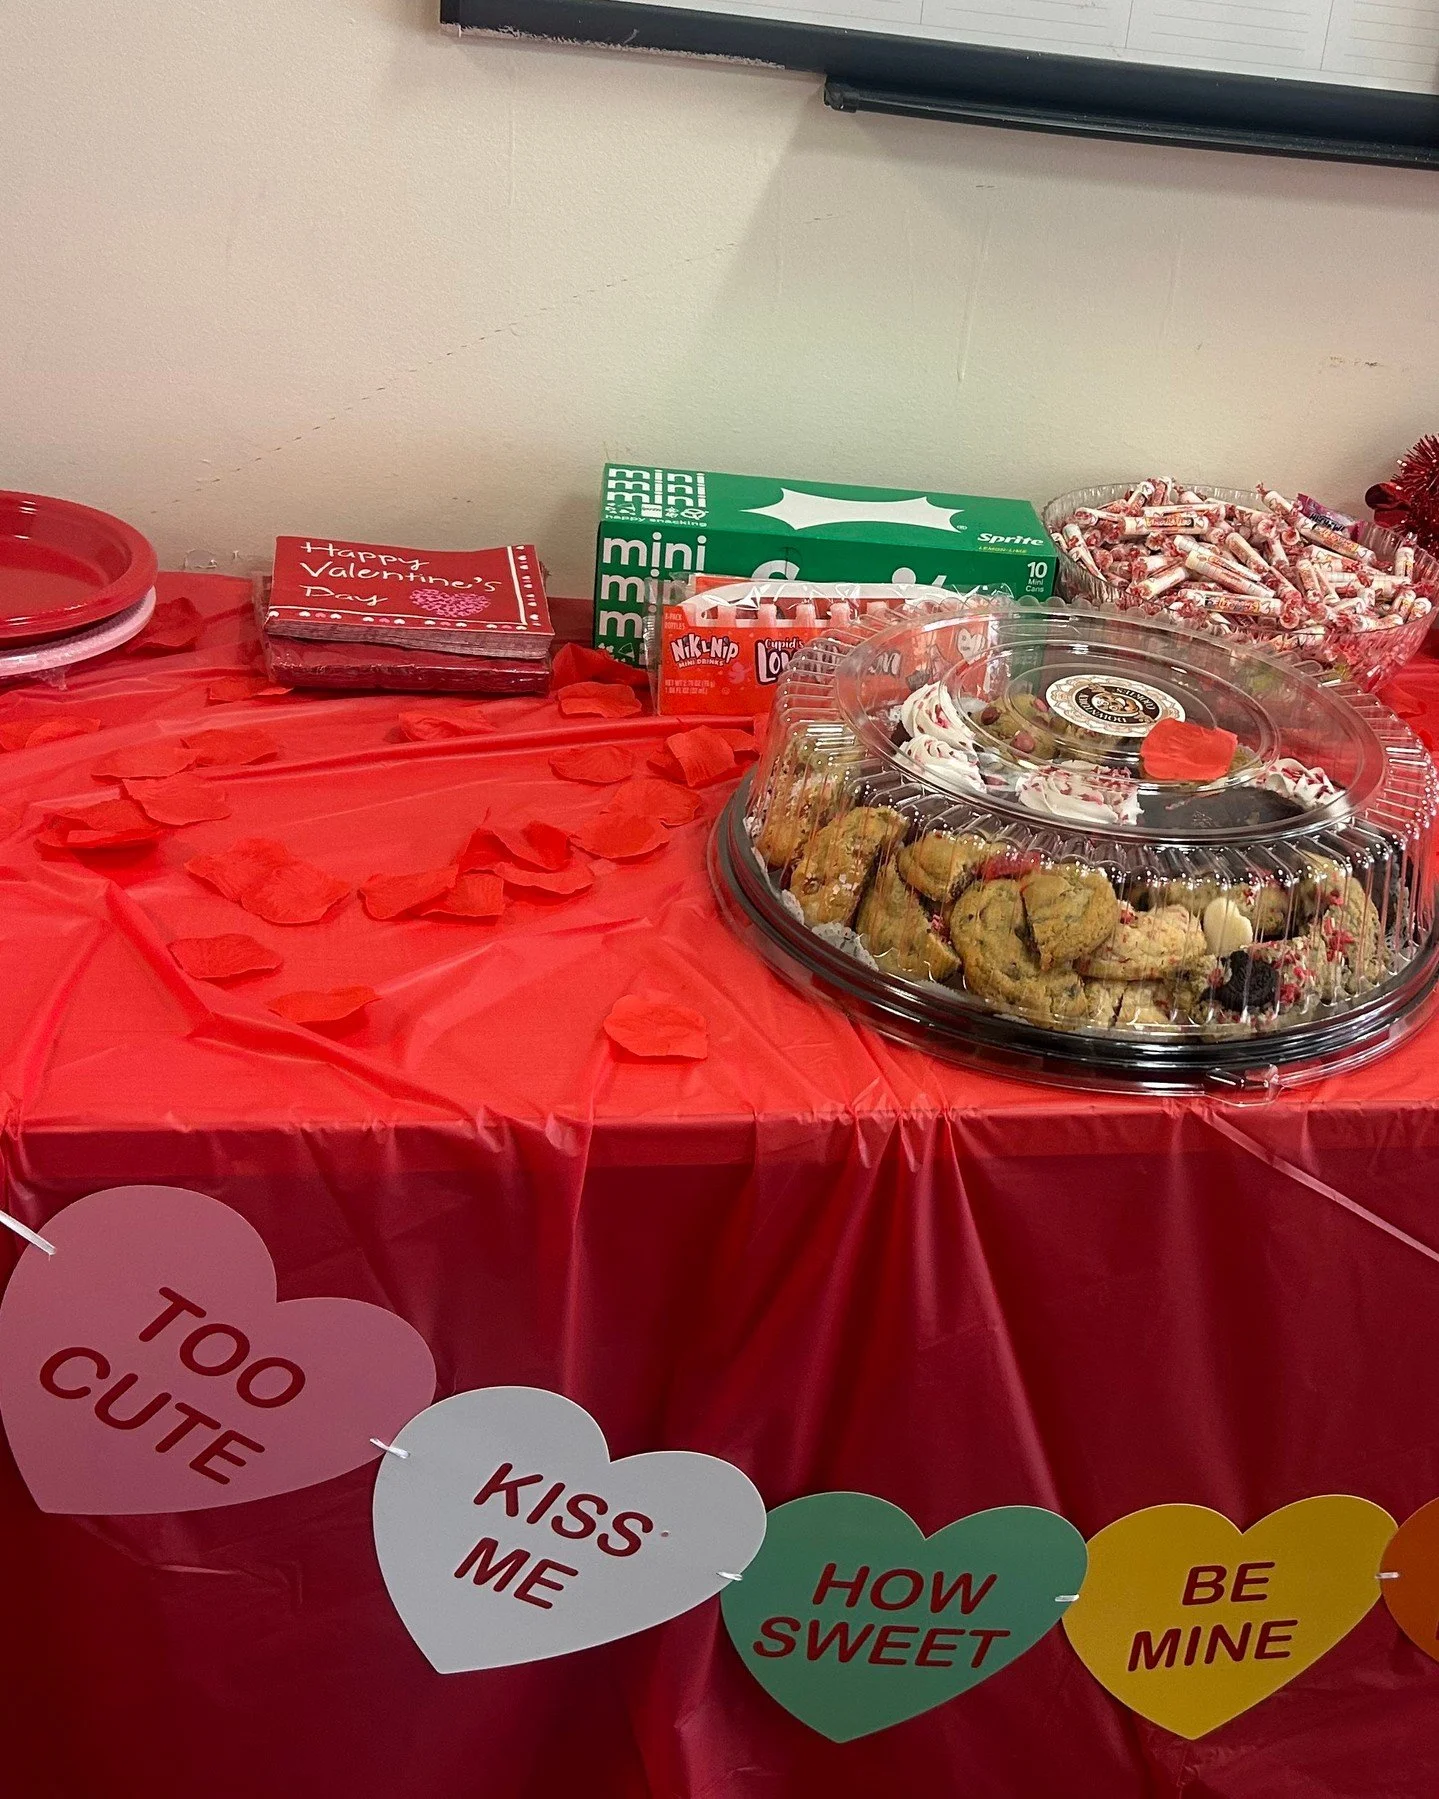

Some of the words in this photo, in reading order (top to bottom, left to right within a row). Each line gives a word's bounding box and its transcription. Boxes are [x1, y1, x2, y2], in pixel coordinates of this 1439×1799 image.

[607, 479, 706, 496] mini
[608, 468, 705, 484] mini
[606, 491, 707, 508] mini
[605, 514, 646, 523] happy
[649, 518, 708, 528] snacking
[602, 531, 708, 572] mini
[977, 532, 1045, 546] Sprite
[300, 541, 430, 570] Happy
[1027, 561, 1048, 579] 10
[299, 560, 503, 593] Valentine's
[1025, 585, 1045, 593] Cans
[299, 584, 389, 607] Day
[678, 660, 696, 669] MINI
[697, 658, 725, 667] DRINKS
[138, 1286, 306, 1409] TOO
[39, 1346, 266, 1485] CUTE
[473, 1462, 654, 1558] KISS
[453, 1537, 580, 1610] ME
[812, 1562, 998, 1615] HOW
[1181, 1561, 1276, 1606] BE
[752, 1616, 1011, 1669] SWEET
[1127, 1619, 1299, 1672] MINE
